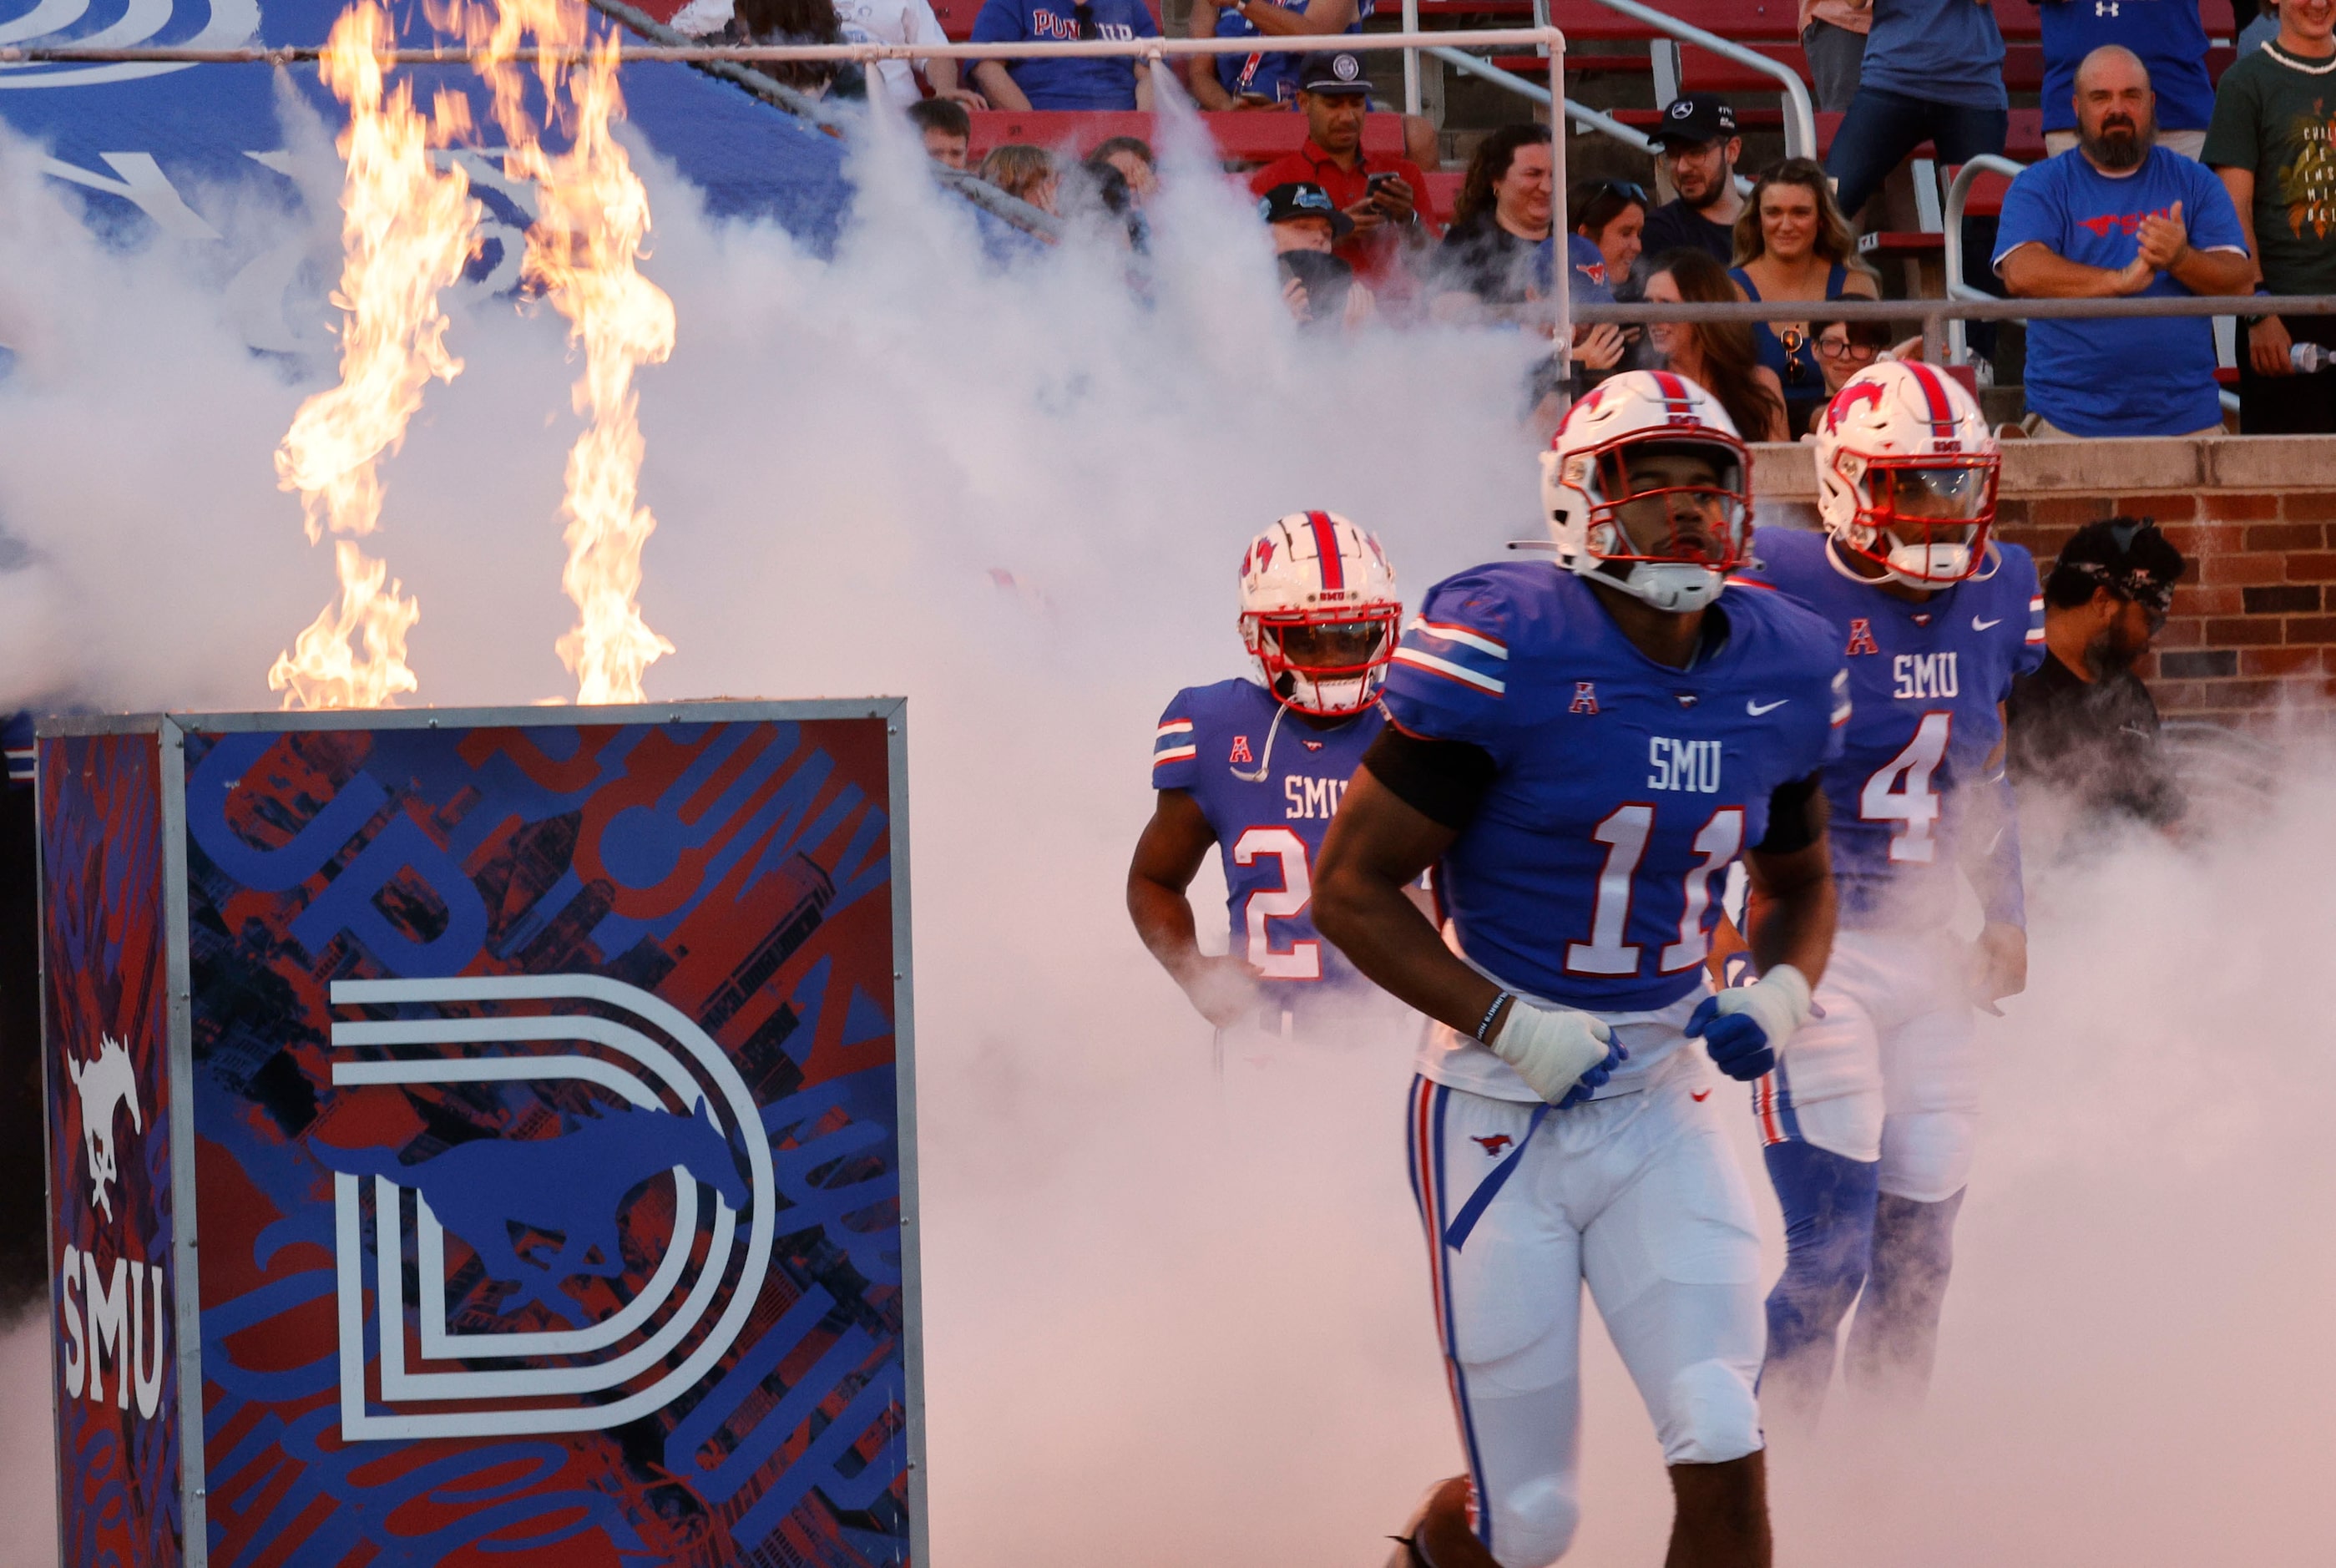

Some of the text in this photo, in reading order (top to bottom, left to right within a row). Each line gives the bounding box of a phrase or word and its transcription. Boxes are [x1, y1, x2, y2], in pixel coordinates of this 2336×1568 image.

[1893, 651, 1959, 699] SMU
[1284, 774, 1349, 820] SMU
[1647, 736, 1722, 793] SMU
[1859, 709, 1954, 863] 4
[1232, 824, 1323, 982] 2
[1563, 800, 1747, 979] 11
[62, 1242, 164, 1420] SMU
